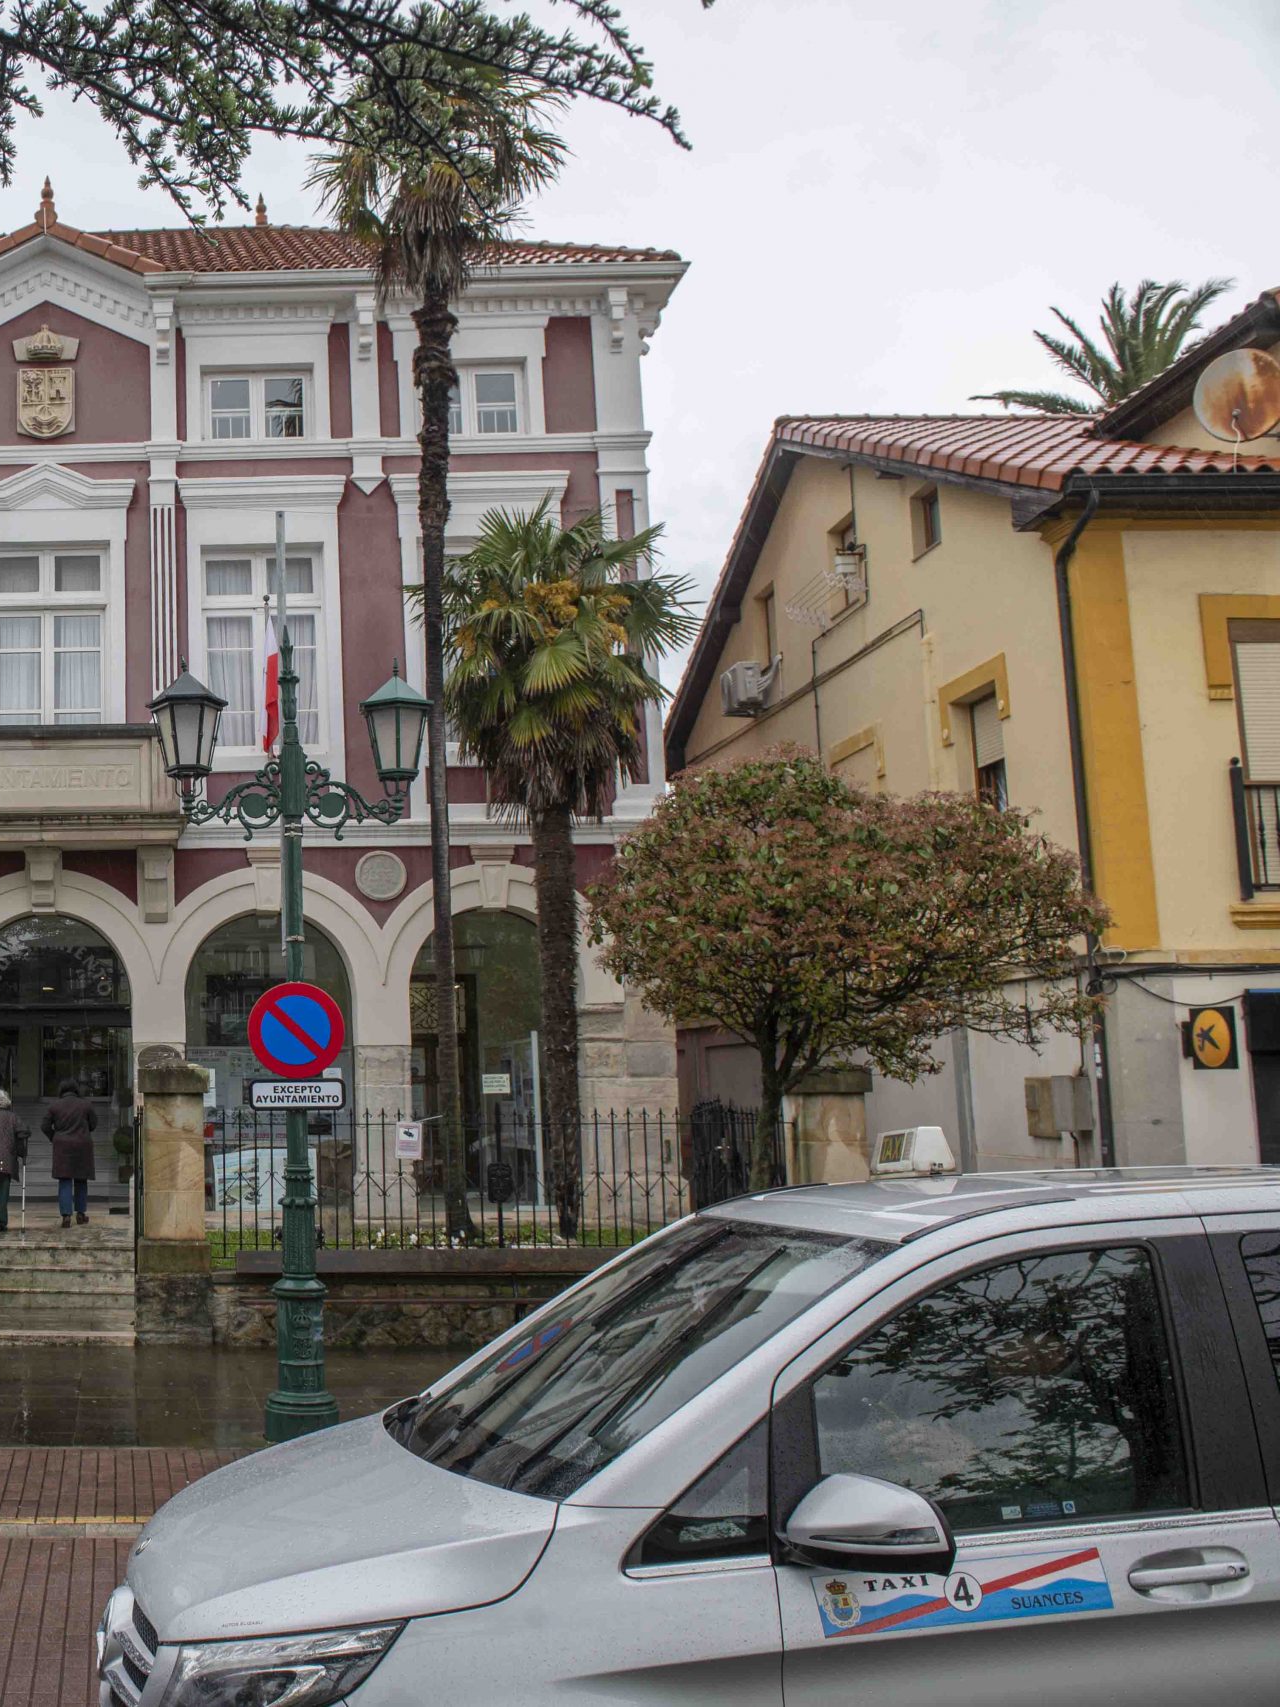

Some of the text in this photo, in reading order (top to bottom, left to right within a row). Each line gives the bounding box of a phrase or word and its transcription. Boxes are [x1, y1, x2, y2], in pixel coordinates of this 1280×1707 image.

[273, 1085, 321, 1094] EXCEPTO
[255, 1095, 340, 1104] AYUNTAMIENTO
[863, 1574, 975, 1607] TAXI 4
[1010, 1591, 1084, 1610] SUANCES
